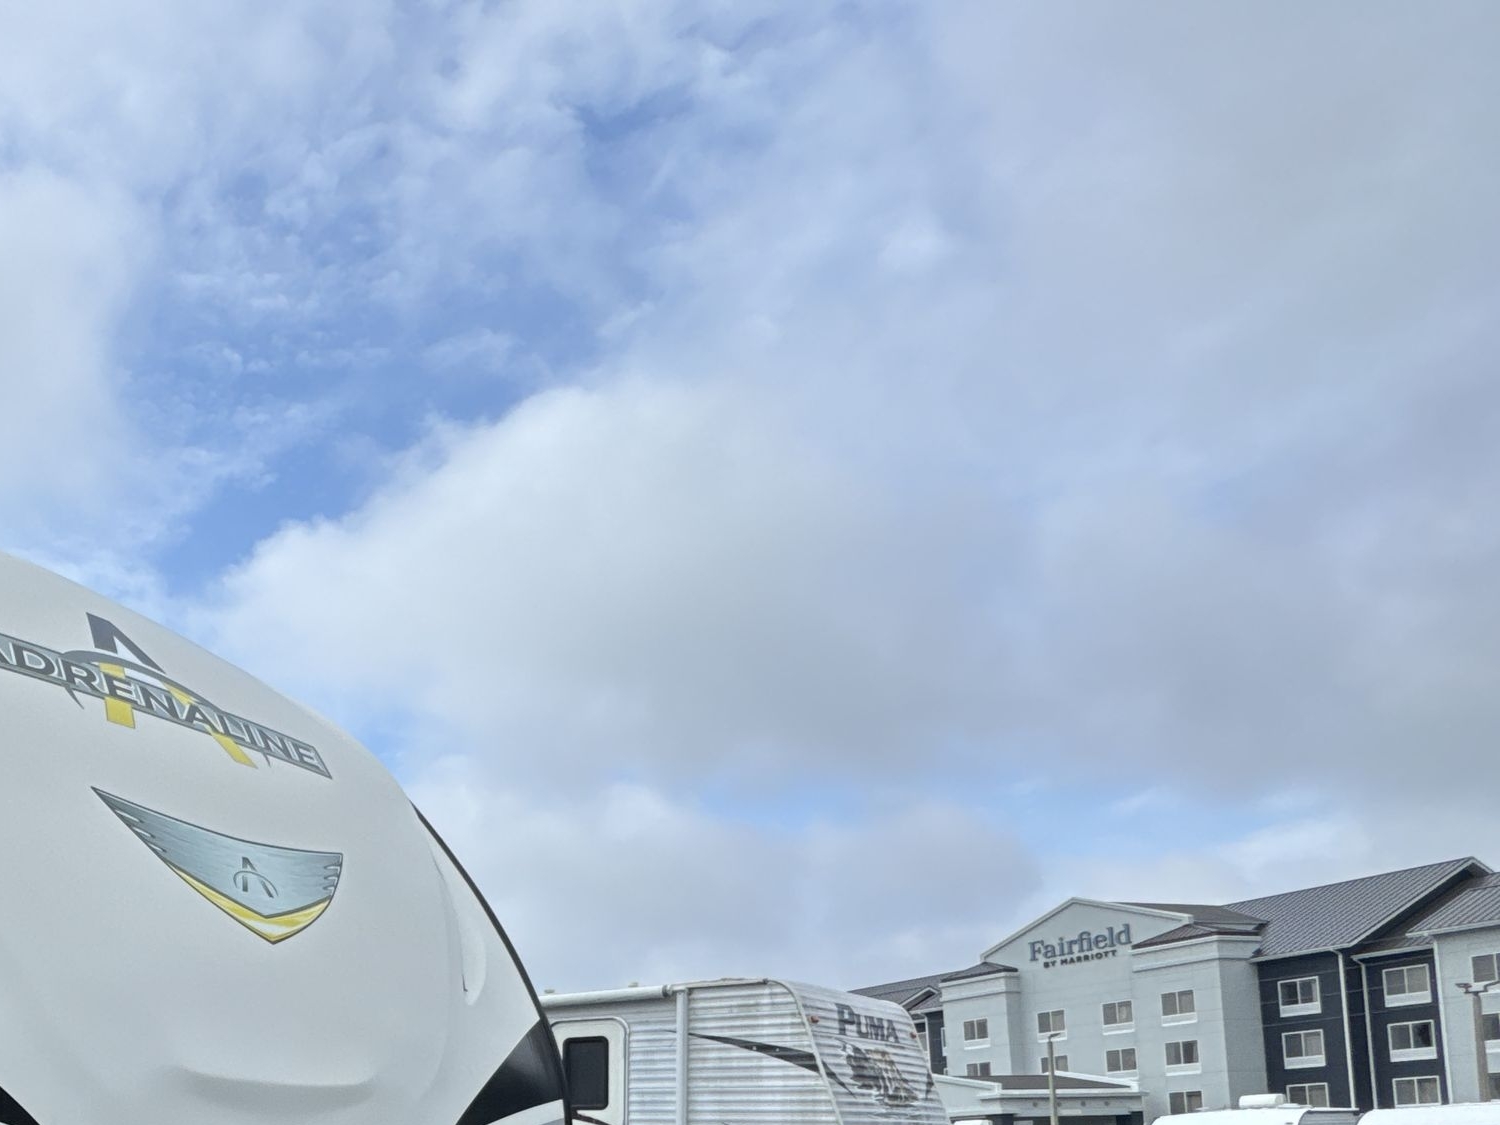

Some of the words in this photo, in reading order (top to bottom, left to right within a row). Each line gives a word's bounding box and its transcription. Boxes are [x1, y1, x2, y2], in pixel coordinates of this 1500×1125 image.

[1028, 923, 1132, 962] Fairfield
[1043, 960, 1057, 969] BY
[1060, 949, 1117, 965] MARRIOTT
[834, 1002, 900, 1043] PUMA
